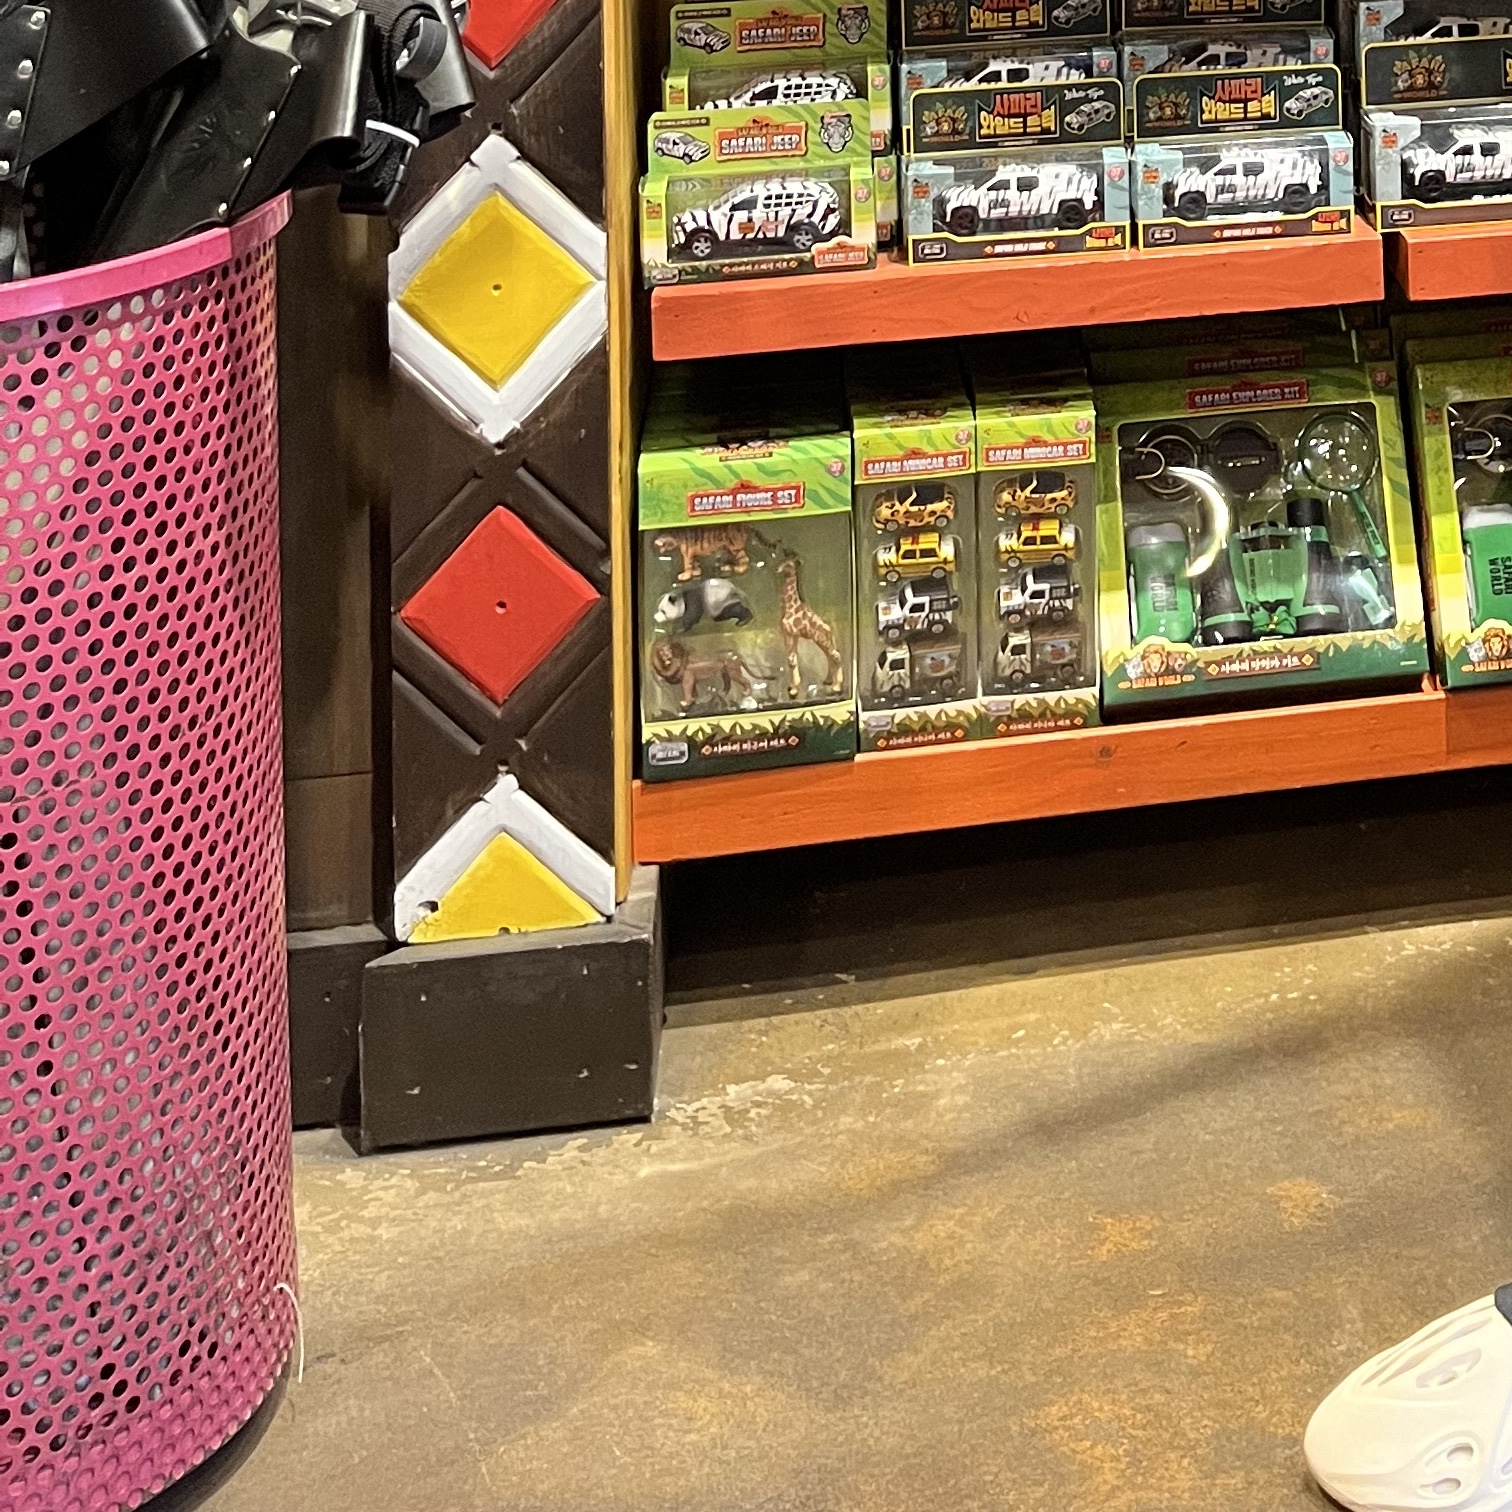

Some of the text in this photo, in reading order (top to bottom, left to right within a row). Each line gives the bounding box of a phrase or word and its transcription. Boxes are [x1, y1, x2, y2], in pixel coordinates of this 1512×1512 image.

[970, 1, 1043, 28] 와일드 트럭
[741, 26, 817, 45] SAFARI JEEP
[1215, 77, 1262, 100] 사파리
[993, 92, 1042, 115] 사파리
[1201, 92, 1275, 121] 와일드 트럭
[980, 108, 1056, 135] 와일드 트럭
[721, 134, 799, 153] SAFARI JEEP
[1195, 386, 1301, 406] SAFARI EXPLORER KIT
[866, 453, 965, 476] SAFARI MINICAR SET
[988, 443, 1085, 463] SAFARI MINICAR SET
[694, 490, 797, 511] SAFARI FIGURE SET
[1488, 557, 1503, 596] WORLD
